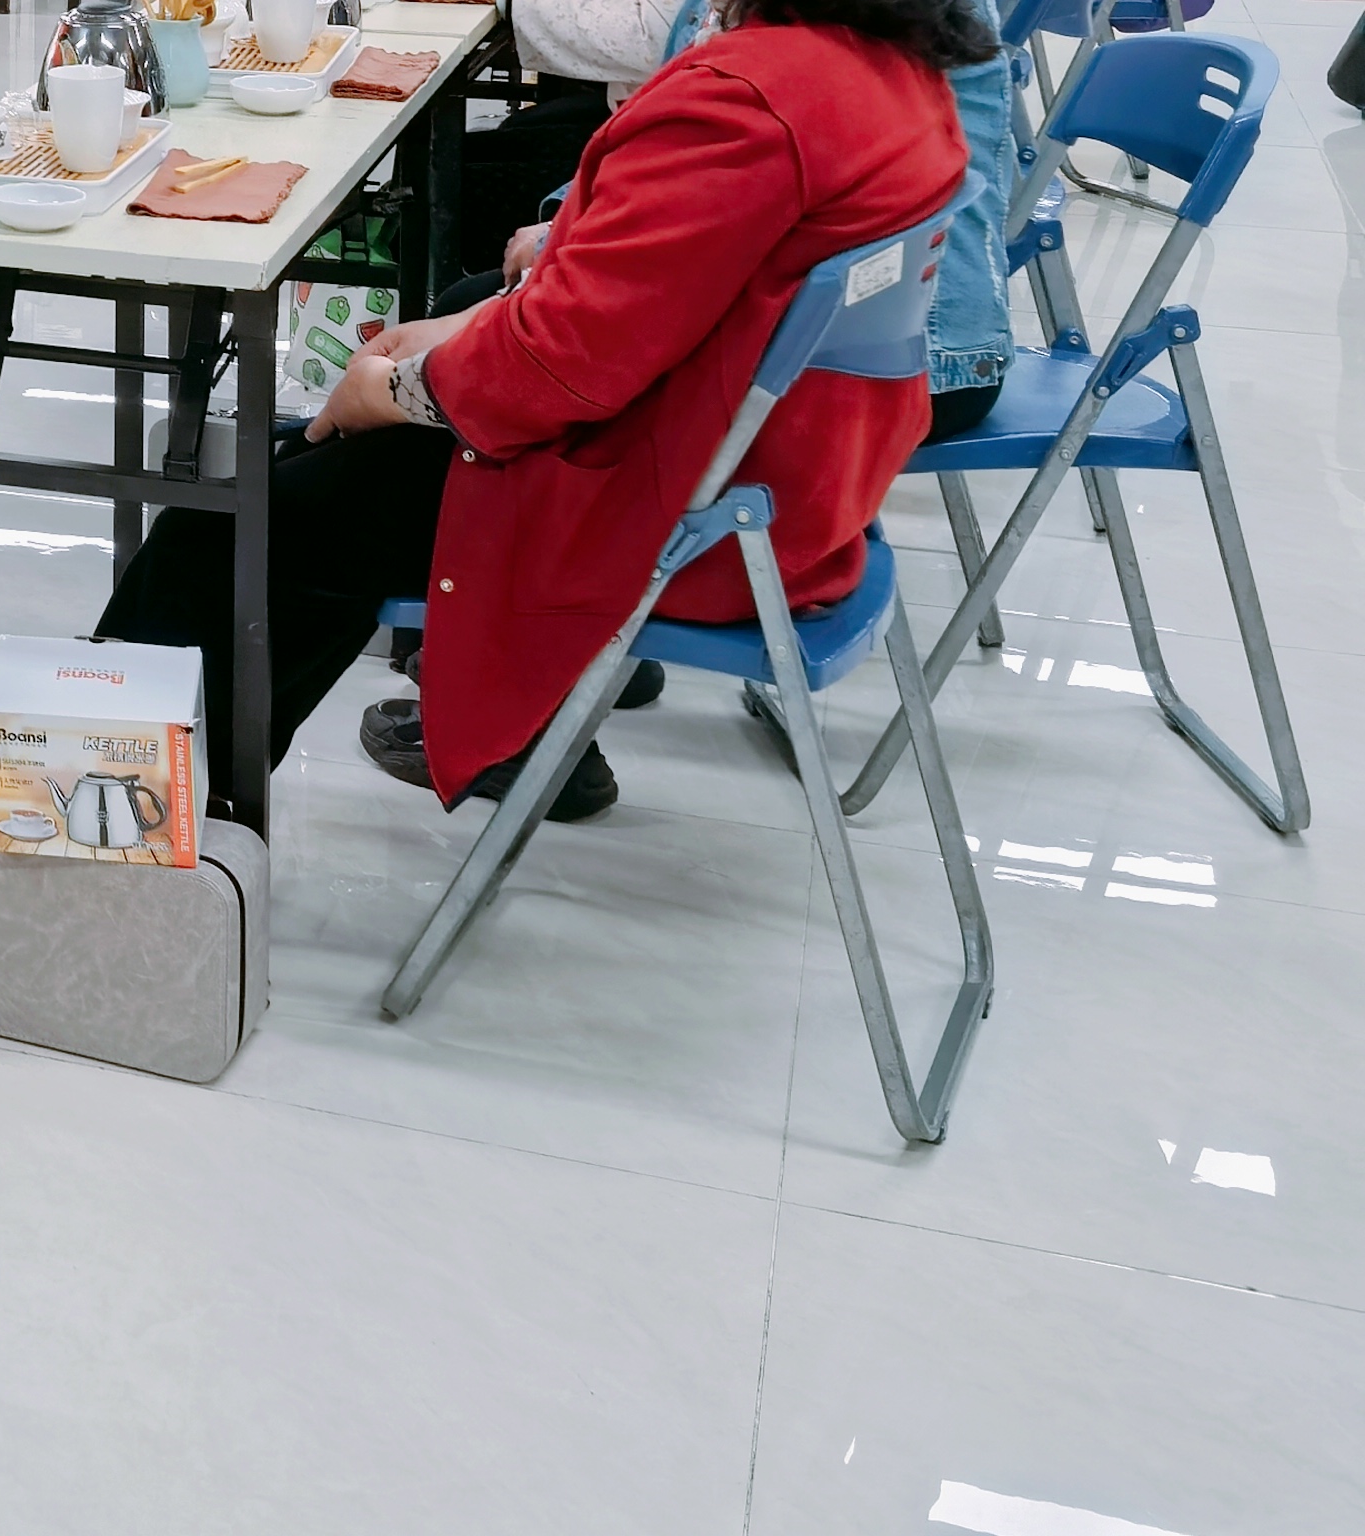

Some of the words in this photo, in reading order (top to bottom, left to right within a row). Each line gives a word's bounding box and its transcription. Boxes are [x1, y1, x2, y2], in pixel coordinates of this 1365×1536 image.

[56, 669, 125, 685] Boansi
[82, 735, 159, 754] KETTLE
[174, 733, 186, 785] STAINLESS
[177, 785, 187, 816] STEEL
[179, 816, 190, 853] KETTLE
